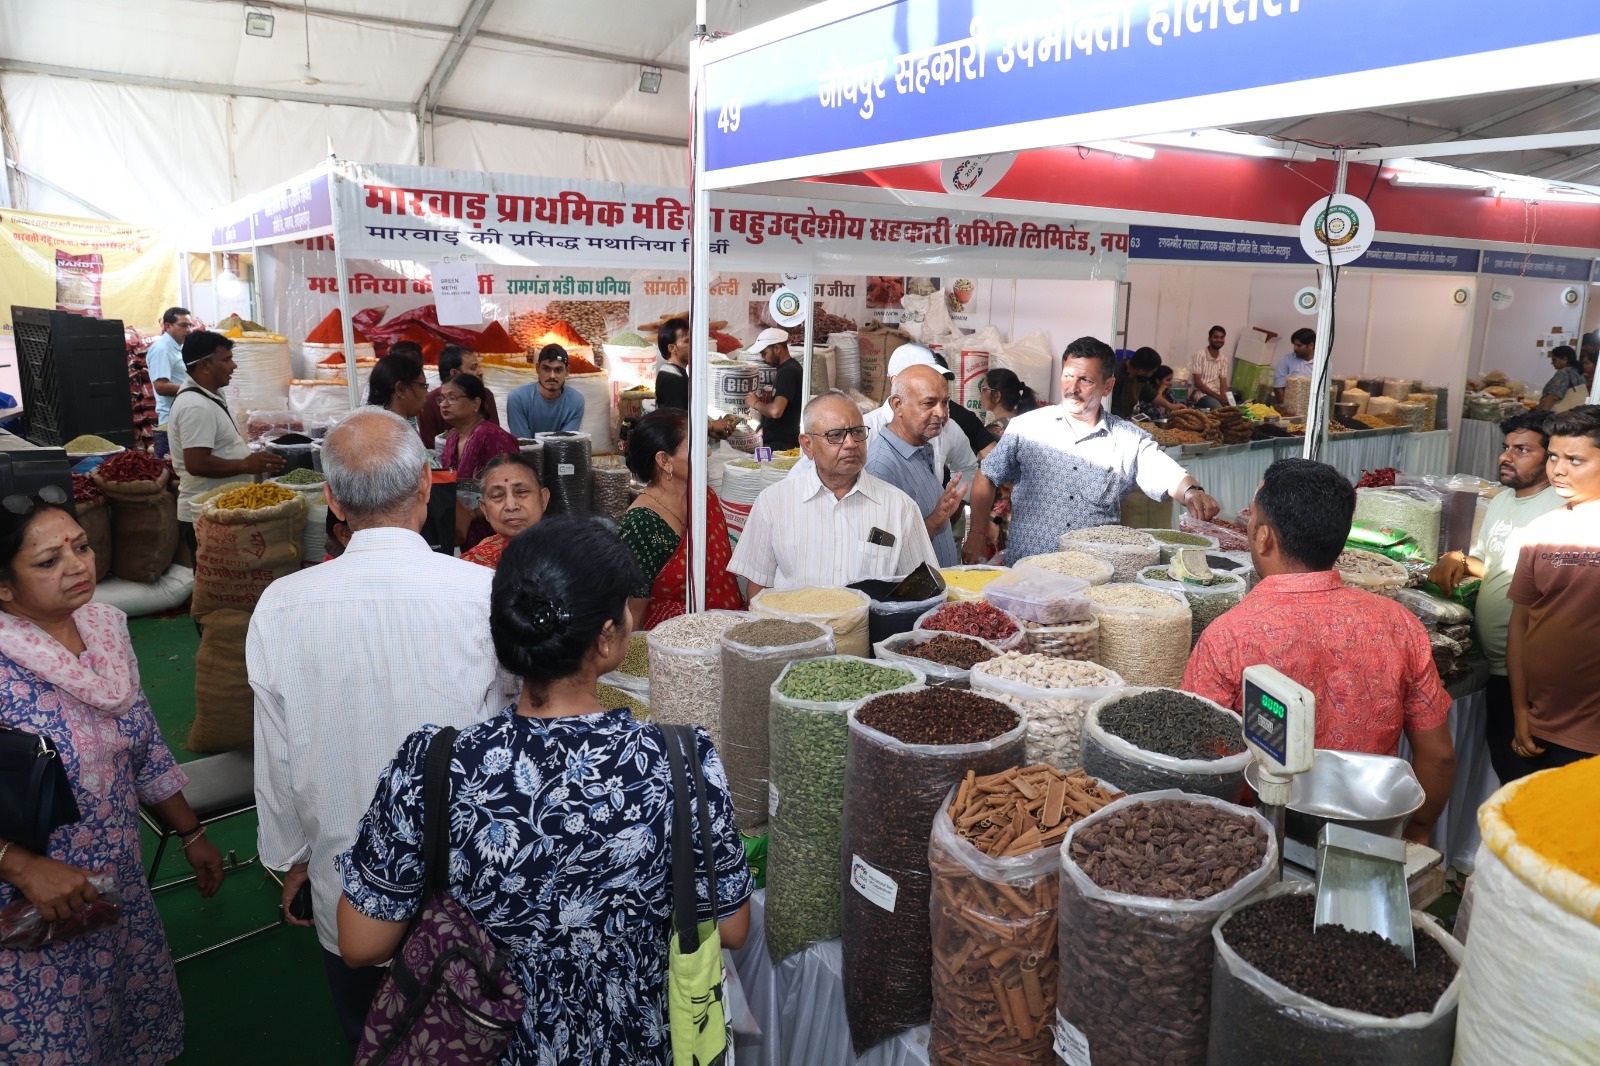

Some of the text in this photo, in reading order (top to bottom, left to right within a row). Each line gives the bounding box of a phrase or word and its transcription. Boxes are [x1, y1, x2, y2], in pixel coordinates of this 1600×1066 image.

[717, 101, 741, 133] 49
[893, 28, 988, 94] सहकारी
[965, 162, 978, 177] 2025
[364, 185, 489, 229] मारवाड़
[496, 191, 626, 227] प्राथमिक
[870, 216, 951, 245] सहकारी
[955, 219, 1018, 247] समिति
[1019, 222, 1095, 256] लिमिटेड,
[365, 226, 461, 246] मारवाड़
[467, 228, 503, 244] की
[509, 231, 580, 250] प्रसिद्ध
[585, 235, 675, 252] मथानिया
[1130, 237, 1141, 248] 63
[57, 259, 94, 268] NANDI
[507, 274, 550, 295] रामगंज
[552, 274, 575, 295] मंडी
[577, 280, 594, 295] का
[595, 276, 631, 295] धनिया
[644, 276, 688, 295] सांगली
[827, 280, 855, 297] जीरा
[727, 378, 749, 392] BIG
